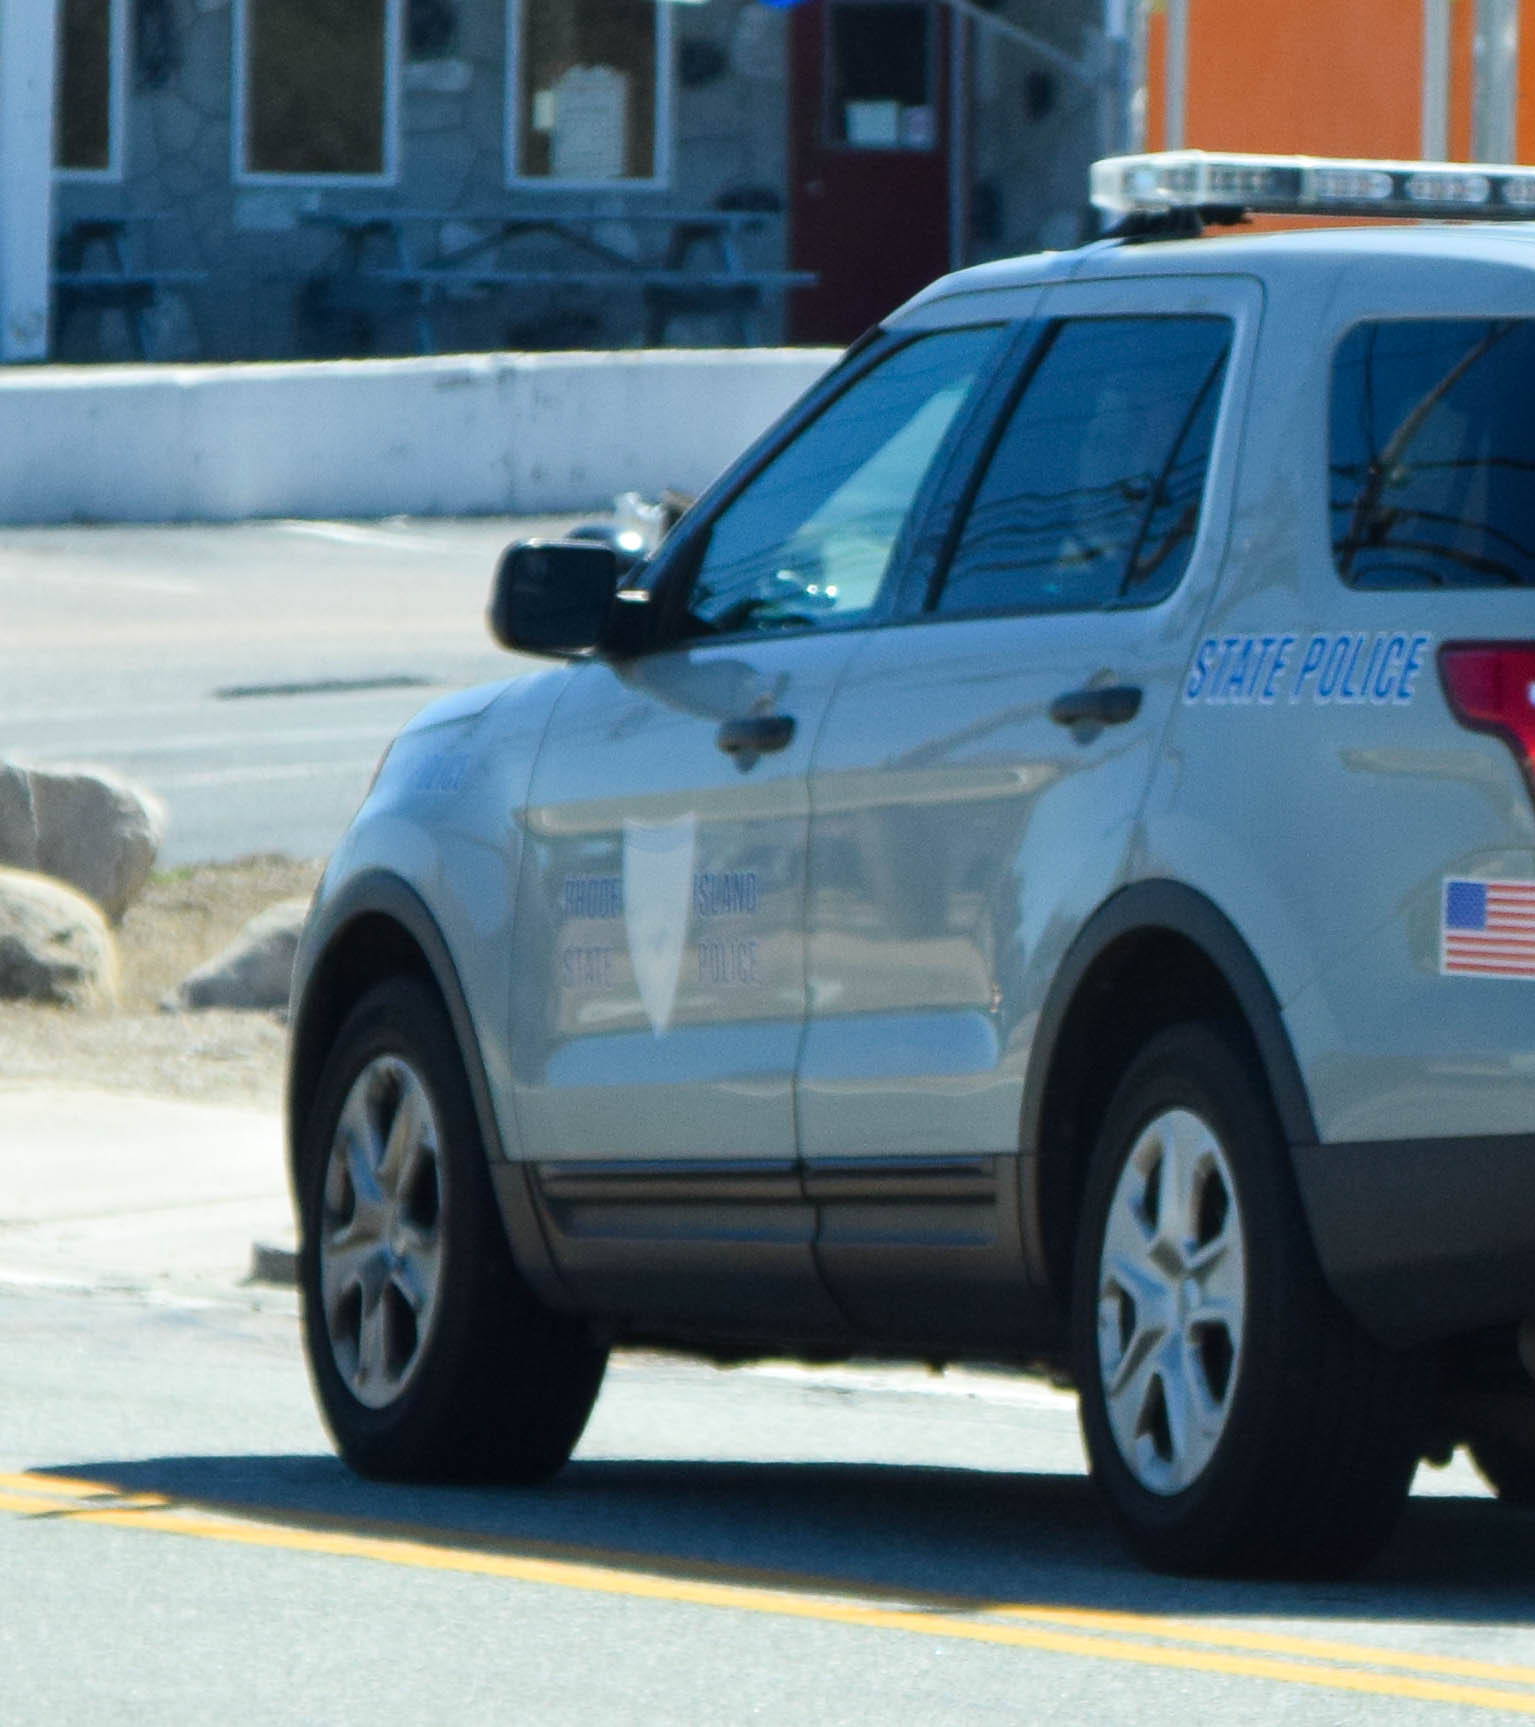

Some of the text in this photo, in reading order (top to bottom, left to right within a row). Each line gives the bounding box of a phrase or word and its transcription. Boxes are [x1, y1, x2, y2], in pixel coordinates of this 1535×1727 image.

[1185, 631, 1430, 704] STATE POLICE
[697, 936, 763, 985] POLICE
